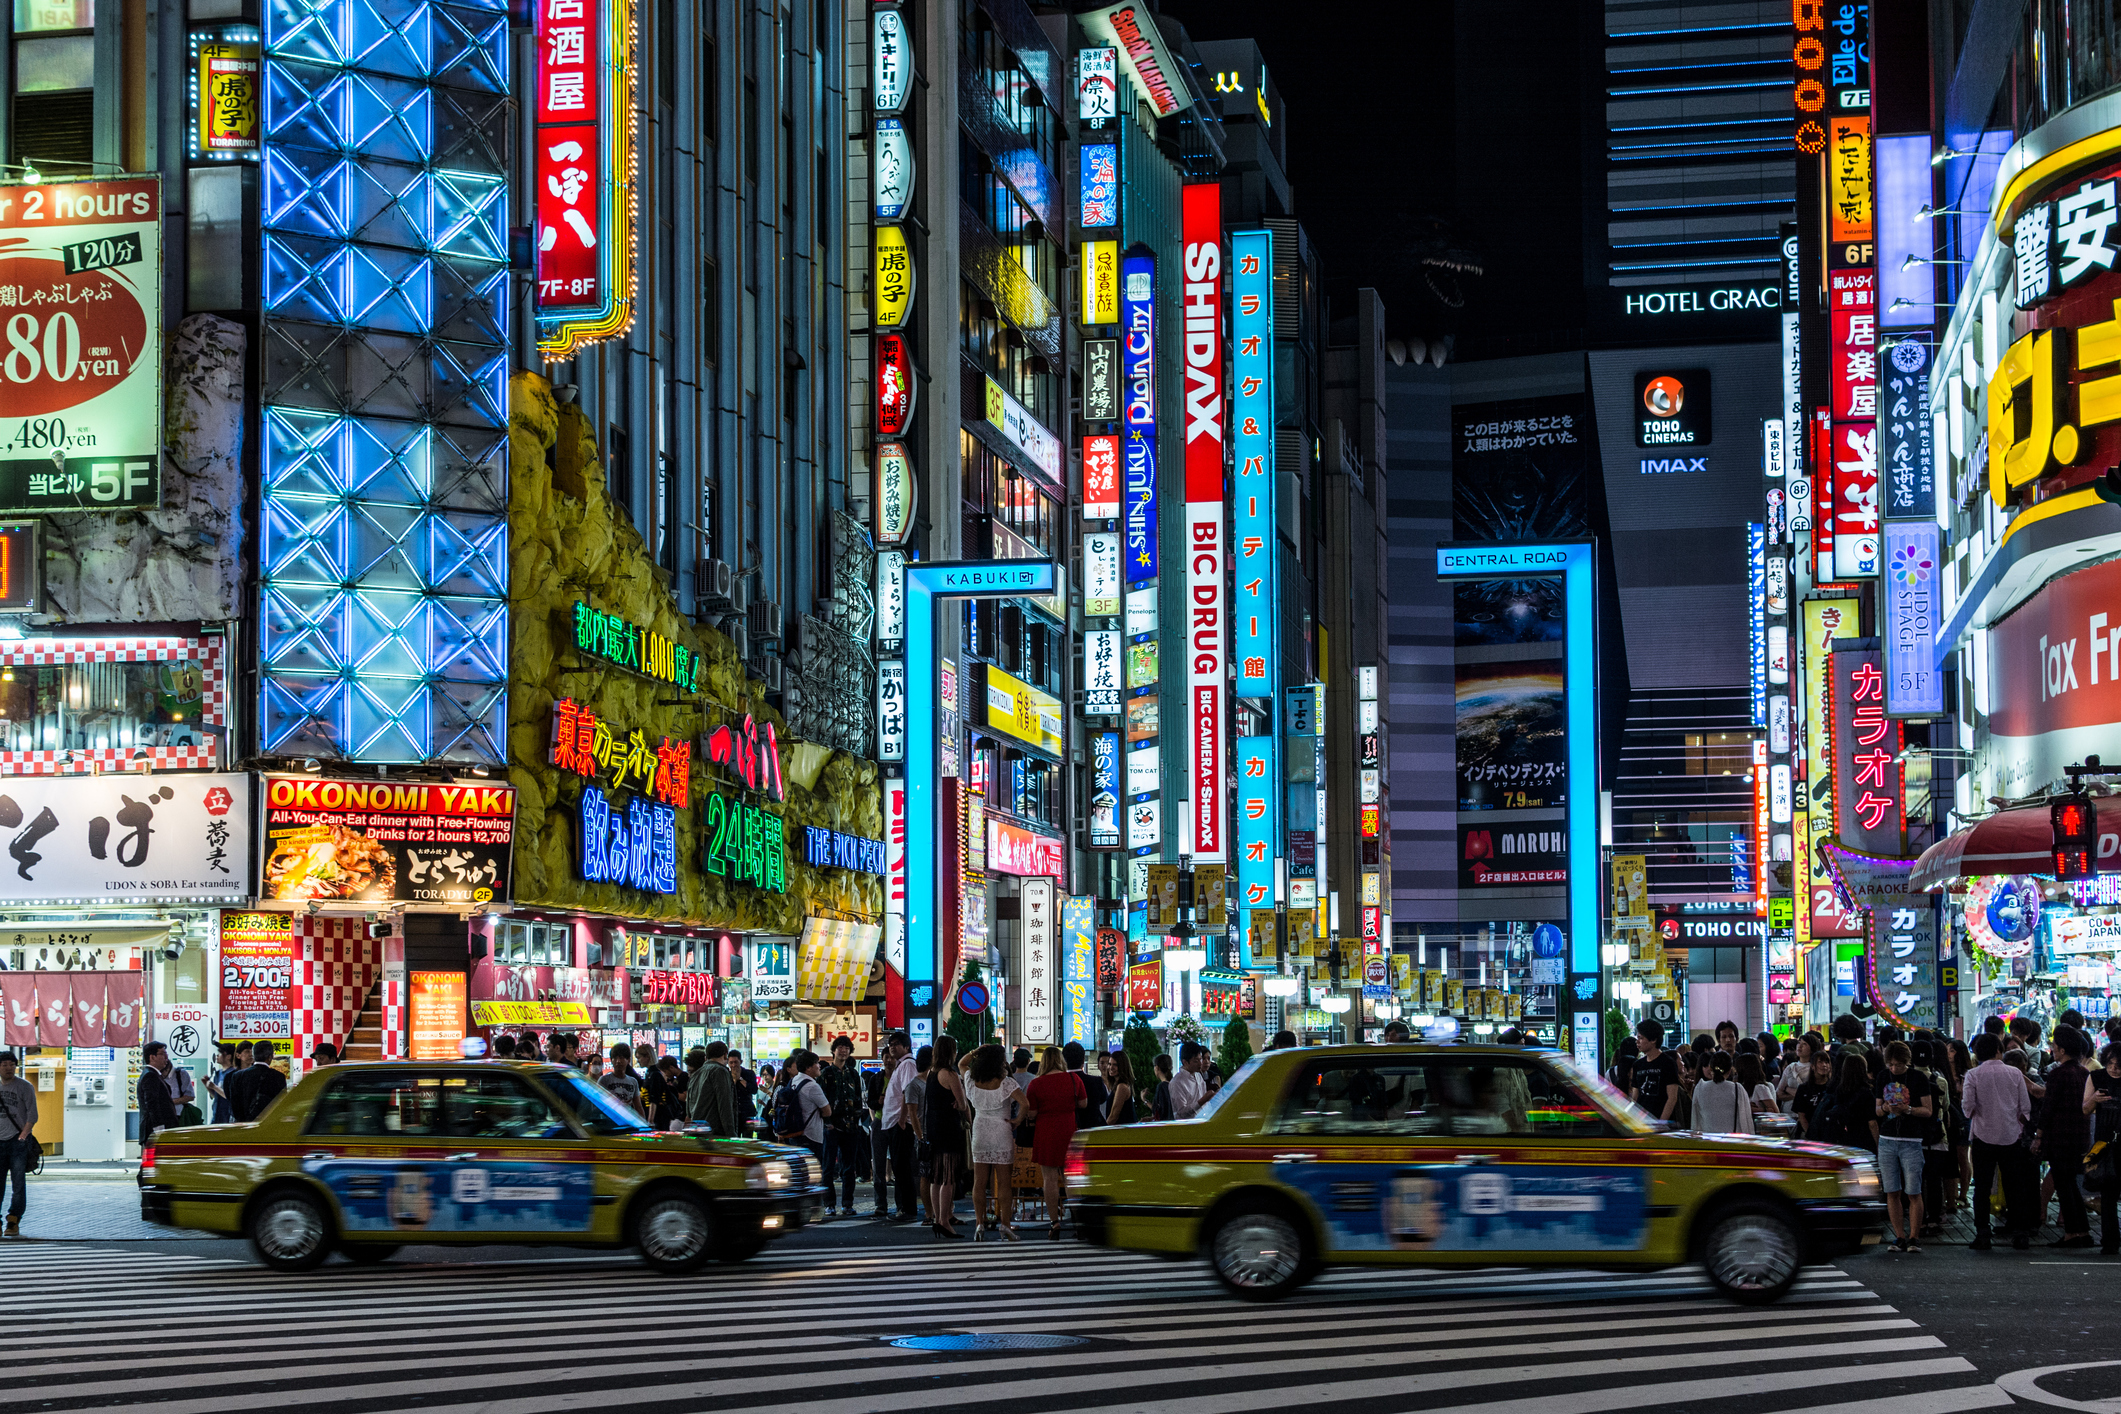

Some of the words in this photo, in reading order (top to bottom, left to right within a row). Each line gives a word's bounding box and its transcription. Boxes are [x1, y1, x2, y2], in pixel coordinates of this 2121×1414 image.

[1832, 4, 1856, 35] de
[204, 45, 229, 56] 4F
[881, 30, 897, 84] ヤキトリ
[1082, 51, 1102, 61] 海鮮
[1110, 8, 1153, 61] SHIDAX
[1134, 57, 1179, 115] KARAOKE
[1832, 38, 1857, 87] Elle
[1082, 61, 1112, 72] 居酒屋
[220, 78, 246, 127] 虎の子
[877, 94, 900, 108] 6F
[1844, 92, 1871, 106] 7F
[1090, 119, 1105, 129] 8F
[210, 138, 256, 148] TORANOKO
[881, 142, 900, 200] うさぎや
[538, 141, 596, 251] つぼ八
[1083, 158, 1115, 226] 海の家
[881, 206, 897, 216] 5F
[69, 240, 136, 272] 120分
[1845, 244, 1873, 263] 6F
[2014, 180, 2119, 309] 驚安
[880, 254, 906, 302] 虎の子
[1097, 251, 1113, 313] 鳥貴族
[1626, 292, 1705, 314] HOTEL
[1710, 287, 1781, 310] GRAC
[879, 312, 896, 322] 4F
[1185, 242, 1221, 445] SHIDAX
[1089, 343, 1112, 409] 山内農場
[1845, 314, 1876, 417] 居楽屋
[989, 387, 1001, 422] 3F
[1095, 409, 1106, 417] 5F
[1464, 414, 1574, 438] この日が来ることを
[1643, 420, 1680, 432] TOHO
[1643, 432, 1694, 444] CINEMAS
[1464, 430, 1578, 453] 人類はわかっていた。
[1770, 430, 1781, 472] 東京ビル
[1889, 376, 1916, 507] かんかん商店
[1240, 255, 1265, 678] カラオケ&パーティー館
[1641, 457, 1706, 474] IMAX
[29, 474, 85, 496] 当ビル
[90, 462, 151, 502] 5F
[1794, 485, 1806, 495] 8F
[885, 459, 901, 532] お好み焼き
[1794, 521, 1807, 531] 5F
[1193, 521, 1217, 576] BIC
[1444, 554, 1519, 567] CENTRAL
[1524, 552, 1568, 564] ROAD
[888, 571, 903, 636] とらそば
[1094, 600, 1112, 612] 3F
[1128, 608, 1156, 616] Penelope
[1898, 590, 1914, 653] STAGE
[1914, 590, 1929, 642] IDOL
[1193, 584, 1218, 675] DRUG
[884, 640, 900, 650] 1F
[1094, 633, 1114, 688] お好み焼
[2039, 634, 2079, 703] Tax
[881, 668, 903, 678] 新宿
[1900, 671, 1929, 691] 5F
[881, 678, 904, 736] かっぱ
[1087, 690, 1119, 705] 大阪家
[1200, 689, 1212, 714] BIC
[554, 697, 691, 809] 東京カラオケ本舗
[710, 713, 785, 802] つぼ八
[884, 742, 902, 754] B1
[1200, 717, 1213, 778] CAMERA
[1851, 663, 1895, 831] カラオケ
[1094, 738, 1113, 789] 海の家
[271, 780, 428, 811] OKONOMI
[439, 787, 514, 814] YAKI
[271, 811, 367, 826] All-You-Can-Eat
[369, 814, 408, 826] dinner
[410, 815, 435, 827] with
[437, 816, 511, 832] Free-Flowing
[707, 734, 785, 894] 24時間
[1201, 787, 1213, 847] SHIDAX
[1363, 810, 1377, 834] 麻雀
[367, 827, 405, 840] Drinks
[408, 828, 425, 841] for
[428, 829, 435, 841] 2
[437, 829, 471, 842] hours
[473, 831, 510, 843] ¥2,700
[583, 785, 676, 894] 飲み放題
[1246, 756, 1268, 904] カラオケ
[1291, 865, 1315, 875] Cafe
[105, 881, 137, 890] UDON
[140, 881, 148, 890] &
[150, 879, 178, 889] SOBA
[181, 880, 198, 889] Eat
[200, 878, 240, 892] standing
[413, 889, 472, 899] TORADYU
[476, 890, 492, 900] 2F
[1851, 884, 1909, 895] KARAOKE
[1065, 899, 1091, 910] パスタ
[223, 914, 292, 931] お好み焼き
[1065, 917, 1091, 929] ピザ
[1684, 922, 1731, 937] TOHO
[2088, 926, 2121, 938] JAPAN
[222, 931, 267, 941] OKONOMI
[270, 931, 292, 941] YAKI
[1029, 917, 1044, 980] 珈琲茶館
[1074, 931, 1092, 981] Miami
[1099, 933, 1117, 986] お好み焼
[1891, 907, 1921, 1014] カラオケ
[224, 967, 290, 989] 2,700円
[411, 973, 463, 984] OKONOMI
[1368, 967, 1386, 977] 消火栓
[425, 984, 452, 994] YAKI
[556, 976, 622, 1000] 東京カラオケ本舗
[649, 970, 714, 1006] カラオケBOX
[754, 984, 793, 996] 虎の子
[1132, 980, 1158, 990] アダム
[1028, 987, 1047, 1008] 集
[1137, 998, 1154, 1009] イヴ
[1032, 1025, 1043, 1033] 2F
